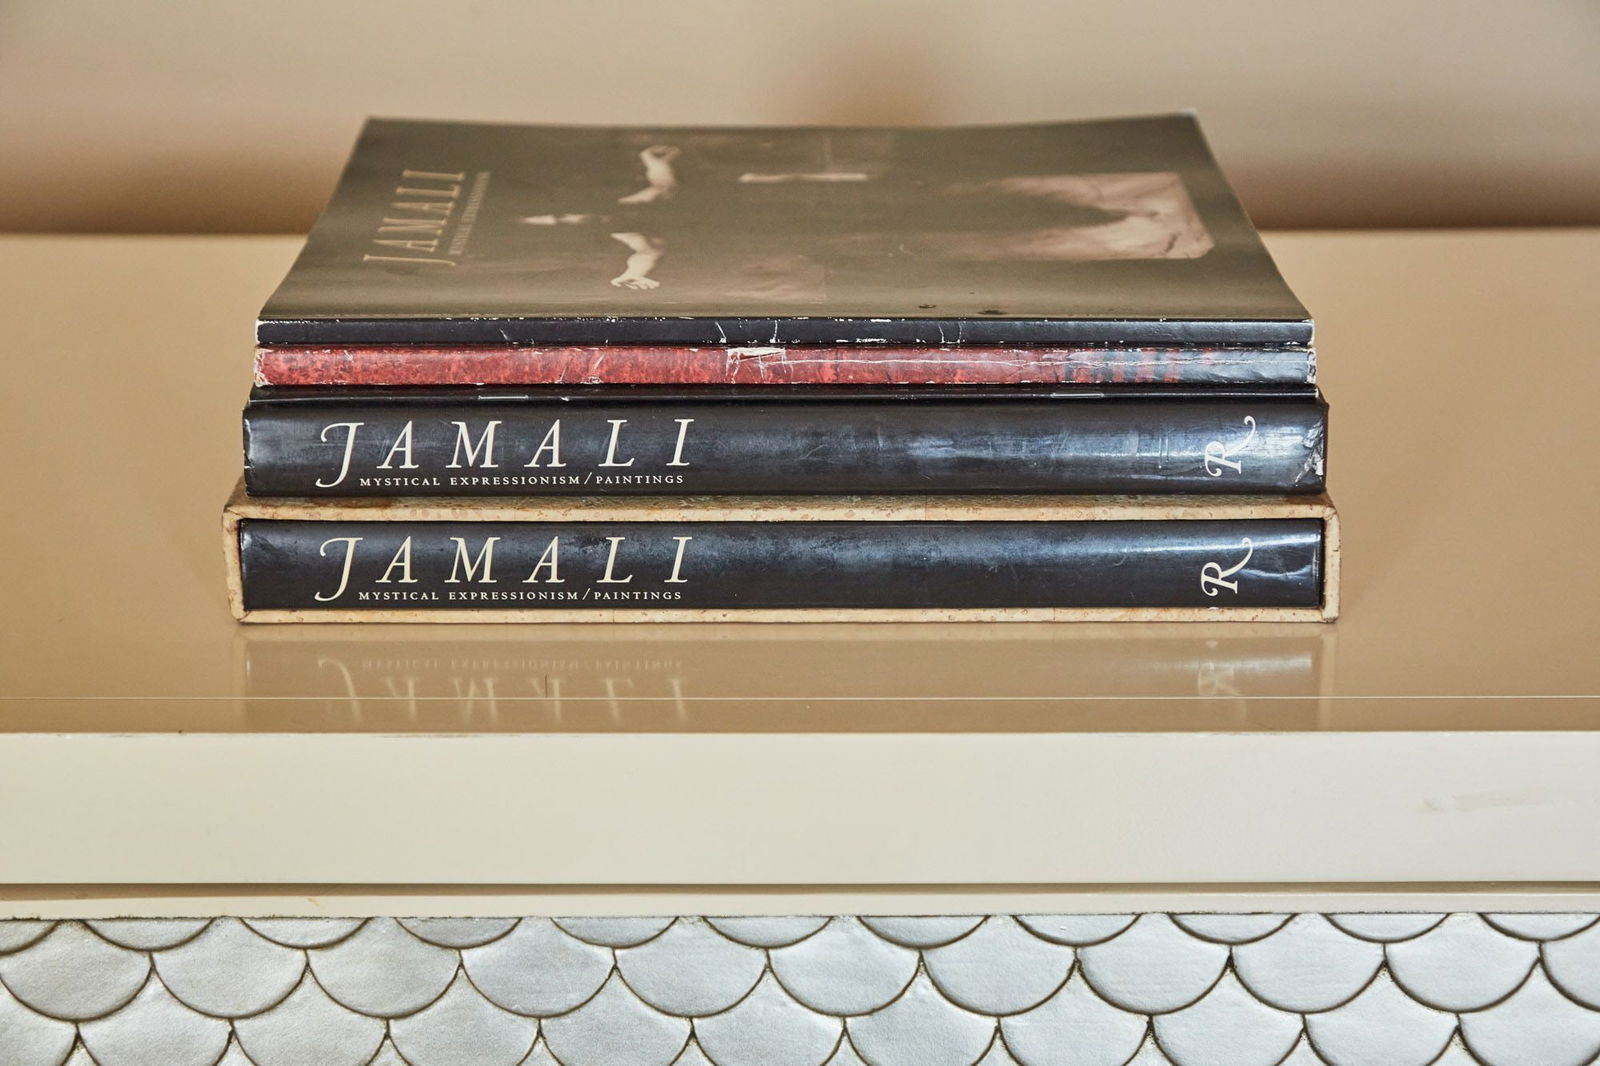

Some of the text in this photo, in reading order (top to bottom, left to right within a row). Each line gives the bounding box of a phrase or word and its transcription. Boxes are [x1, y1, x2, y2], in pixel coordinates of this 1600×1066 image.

[363, 169, 466, 267] JAMALI
[315, 418, 695, 489] JAMALI
[1204, 415, 1256, 478] R
[359, 477, 441, 487] MYSTICAL
[314, 535, 693, 602] JAMALI
[358, 592, 440, 601] MYSTICAL
[1200, 536, 1254, 597] R
